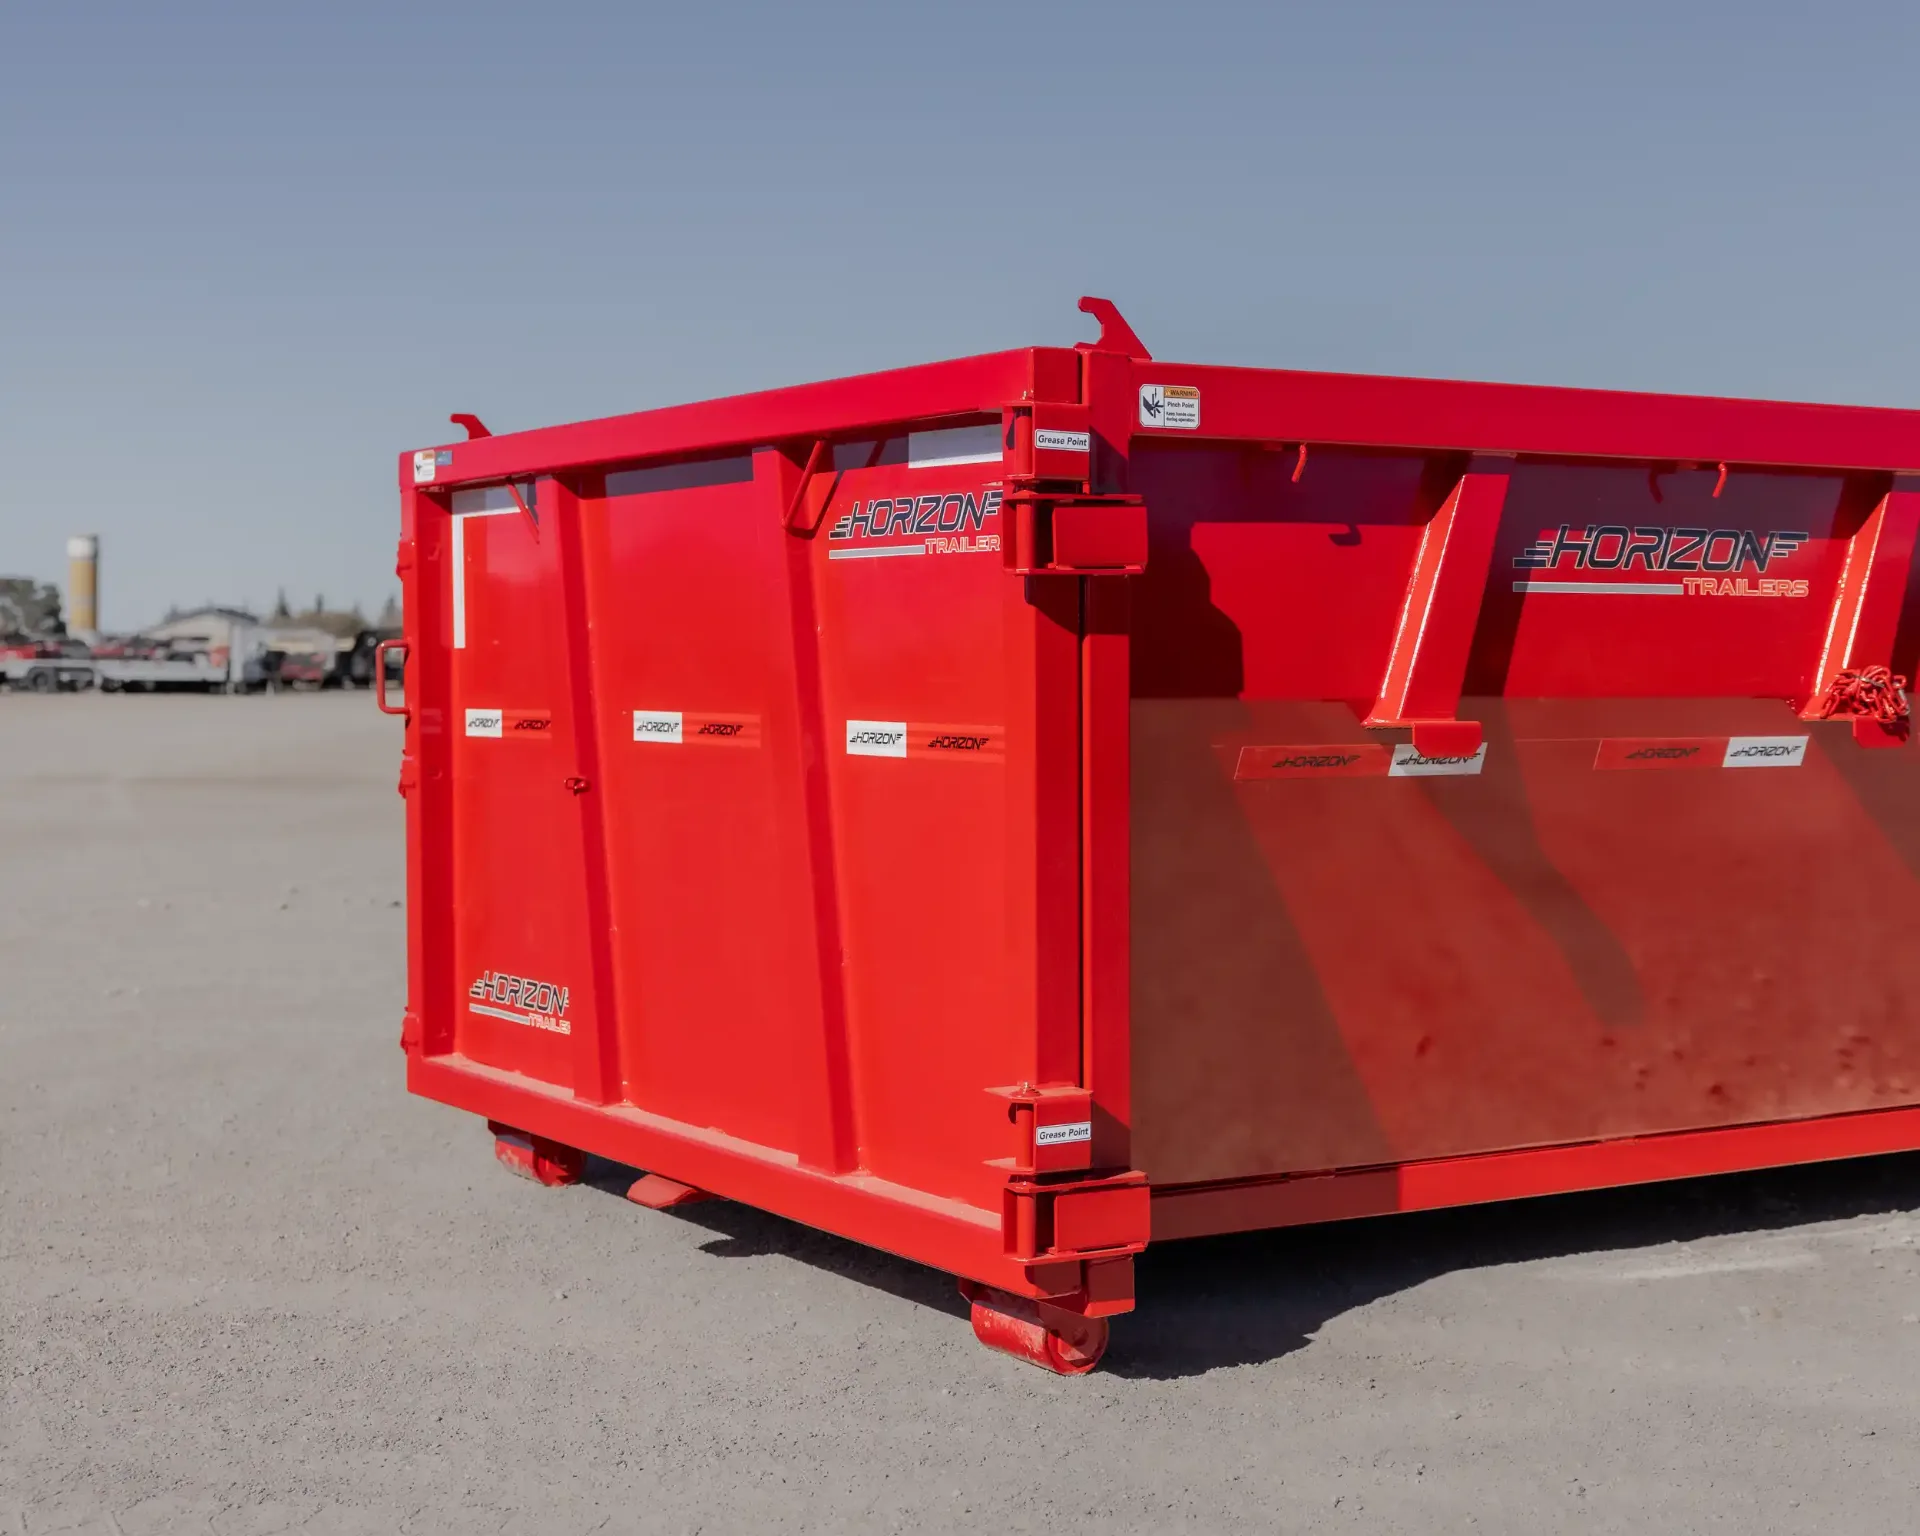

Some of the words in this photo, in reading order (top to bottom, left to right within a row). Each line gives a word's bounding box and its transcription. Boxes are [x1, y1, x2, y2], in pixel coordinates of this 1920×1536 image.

[1038, 434, 1065, 445] Grease
[1066, 437, 1087, 446] Point
[846, 491, 990, 539] HORIZON
[1548, 524, 1778, 573] HORIZON
[1682, 577, 1809, 598] TRAILERS
[640, 721, 677, 733] HORIZON
[702, 723, 740, 736] HORIZON
[855, 731, 899, 745] HORIZON
[933, 736, 983, 750] HORIZON
[1631, 748, 1694, 759] HORIZON
[1736, 746, 1796, 757] HORIZON
[1279, 755, 1353, 768] HORIZON
[479, 970, 569, 1017] HORIZON
[1039, 1131, 1066, 1140] Grease
[1068, 1128, 1088, 1137] Point
